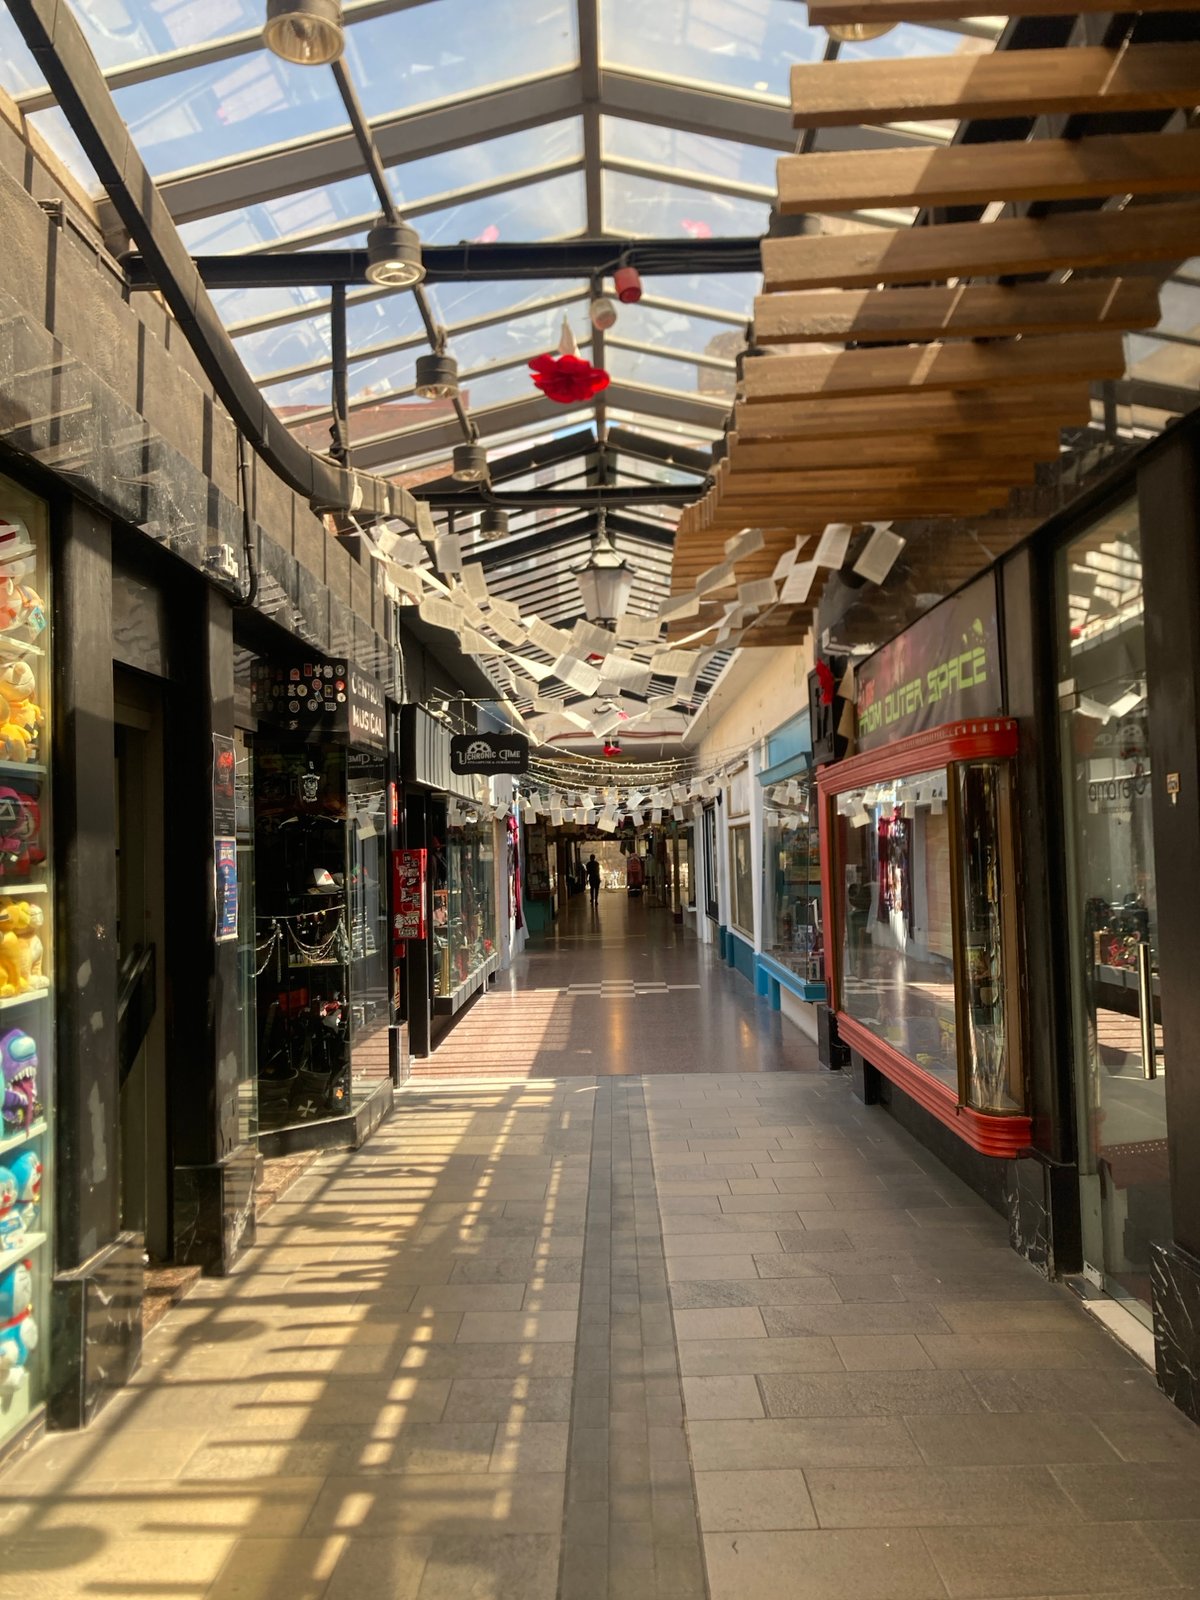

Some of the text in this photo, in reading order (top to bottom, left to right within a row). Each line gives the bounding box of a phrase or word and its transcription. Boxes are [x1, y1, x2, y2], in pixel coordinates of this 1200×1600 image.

[885, 678, 924, 725] OUTER
[927, 646, 987, 704] SPACE
[352, 704, 384, 738] MUSICAL
[456, 749, 521, 765] UCHRONIC TIME
